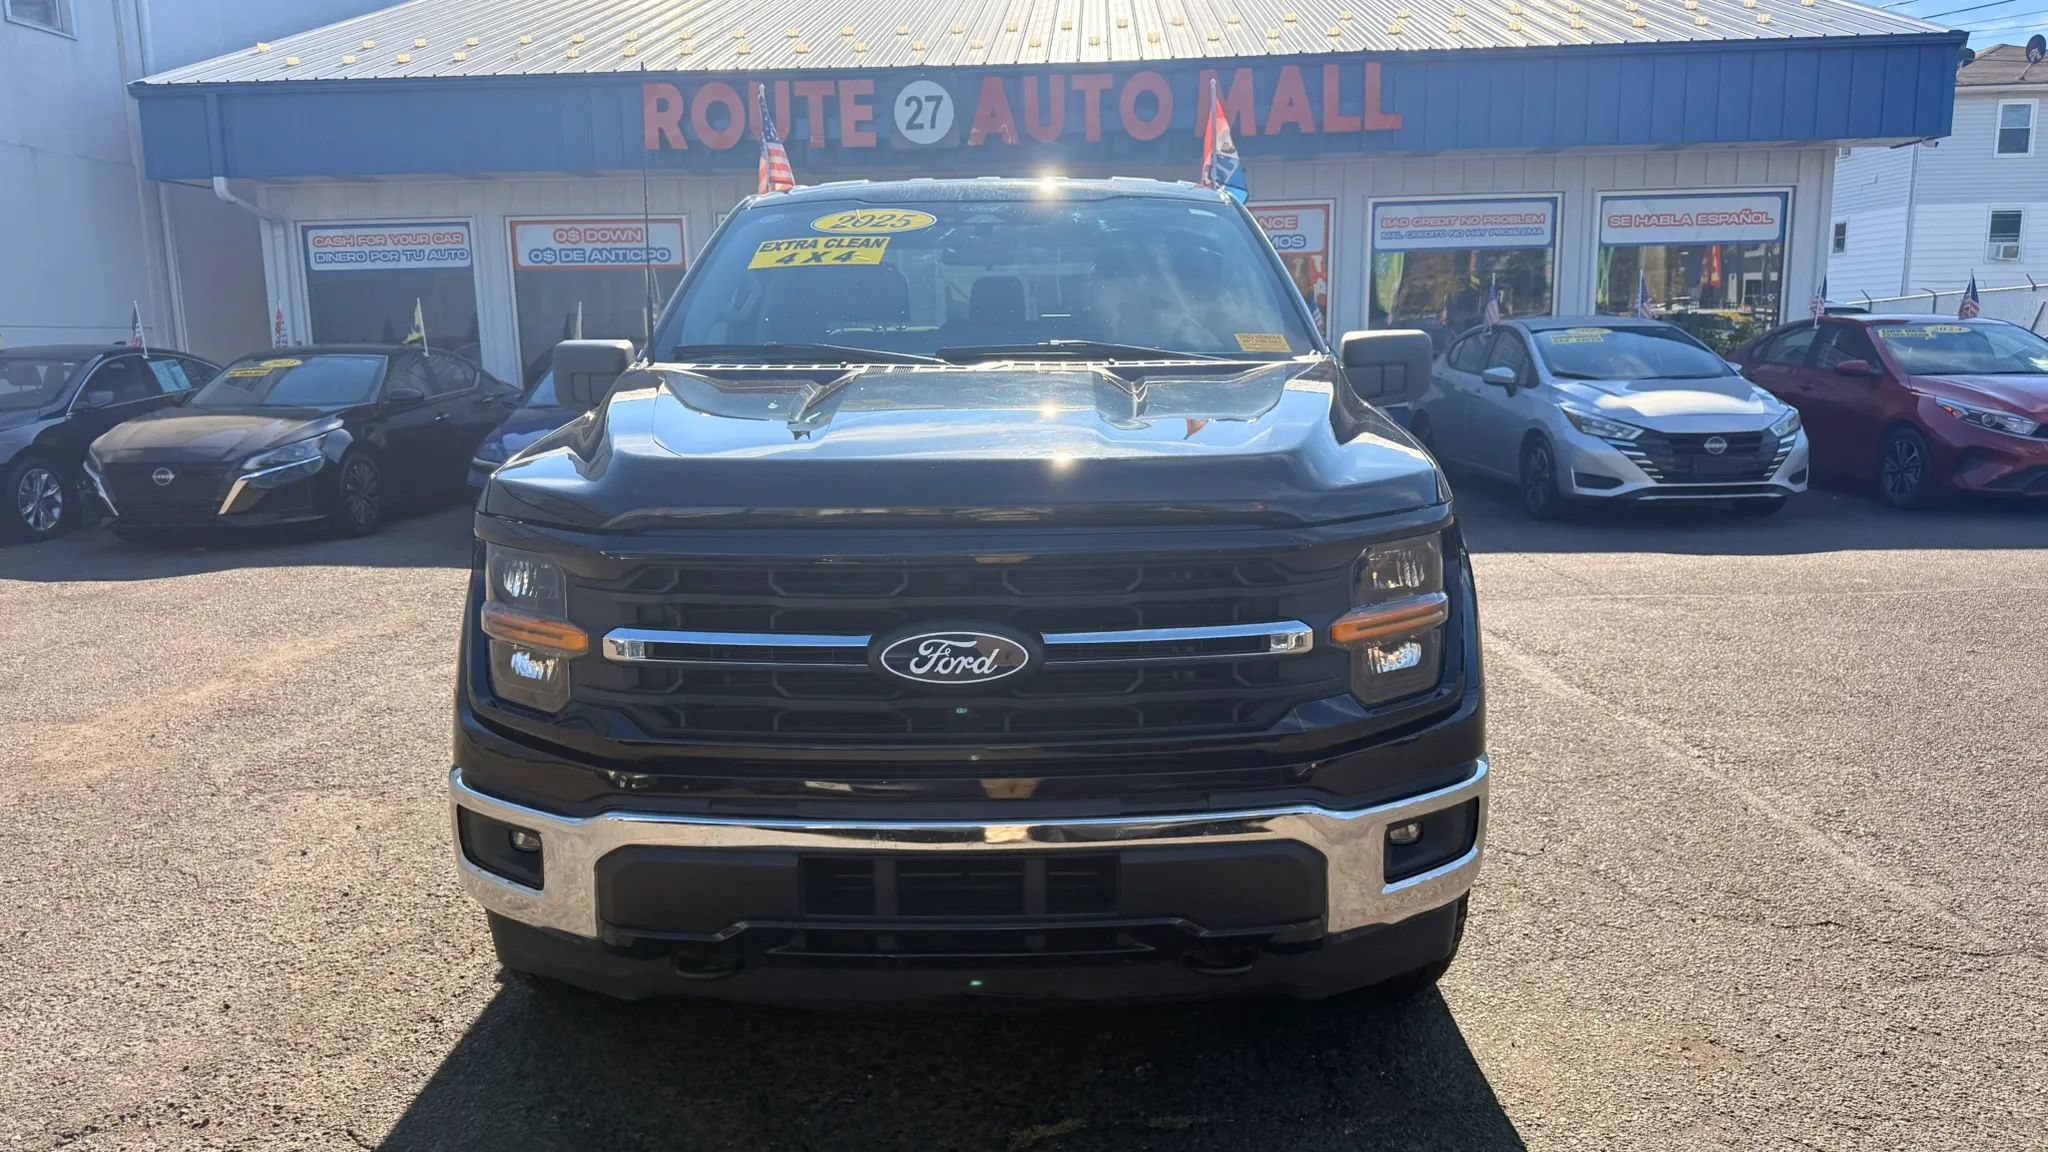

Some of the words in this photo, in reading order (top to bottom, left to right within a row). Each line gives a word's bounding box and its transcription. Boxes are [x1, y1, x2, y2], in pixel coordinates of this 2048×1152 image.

[642, 79, 877, 151] ROUTE
[904, 95, 944, 131] 27
[968, 70, 1173, 146] AUTO
[1195, 62, 1403, 138] MALL
[831, 214, 917, 229] 2025
[1258, 215, 1298, 231] NCE
[1381, 217, 1411, 229] BAD
[1411, 216, 1458, 227] CREDIT
[1459, 215, 1481, 226] NO
[1482, 213, 1546, 225] PROBLEM
[1608, 215, 1633, 228] SE
[1633, 213, 1693, 227] HABLA
[1695, 208, 1774, 226] ESPAÑOL
[312, 235, 354, 248] CASH
[357, 234, 387, 246] FOR
[388, 233, 429, 246] YOUR
[432, 232, 465, 244] CAR
[584, 227, 644, 243] DOWN
[1381, 230, 1405, 240] MAL
[1448, 229, 1465, 238] NO
[1465, 228, 1488, 238] HAY
[1488, 227, 1545, 237] PROBLEMA
[758, 239, 818, 252] EXTRA
[823, 238, 887, 250] CLEAN
[314, 251, 367, 264] DINERO
[369, 251, 400, 263] POR
[403, 250, 424, 262] TU
[427, 248, 469, 260] AUTO
[559, 248, 587, 263] DE
[587, 247, 671, 263] ANTICIPO
[909, 639, 1000, 675] Ford
